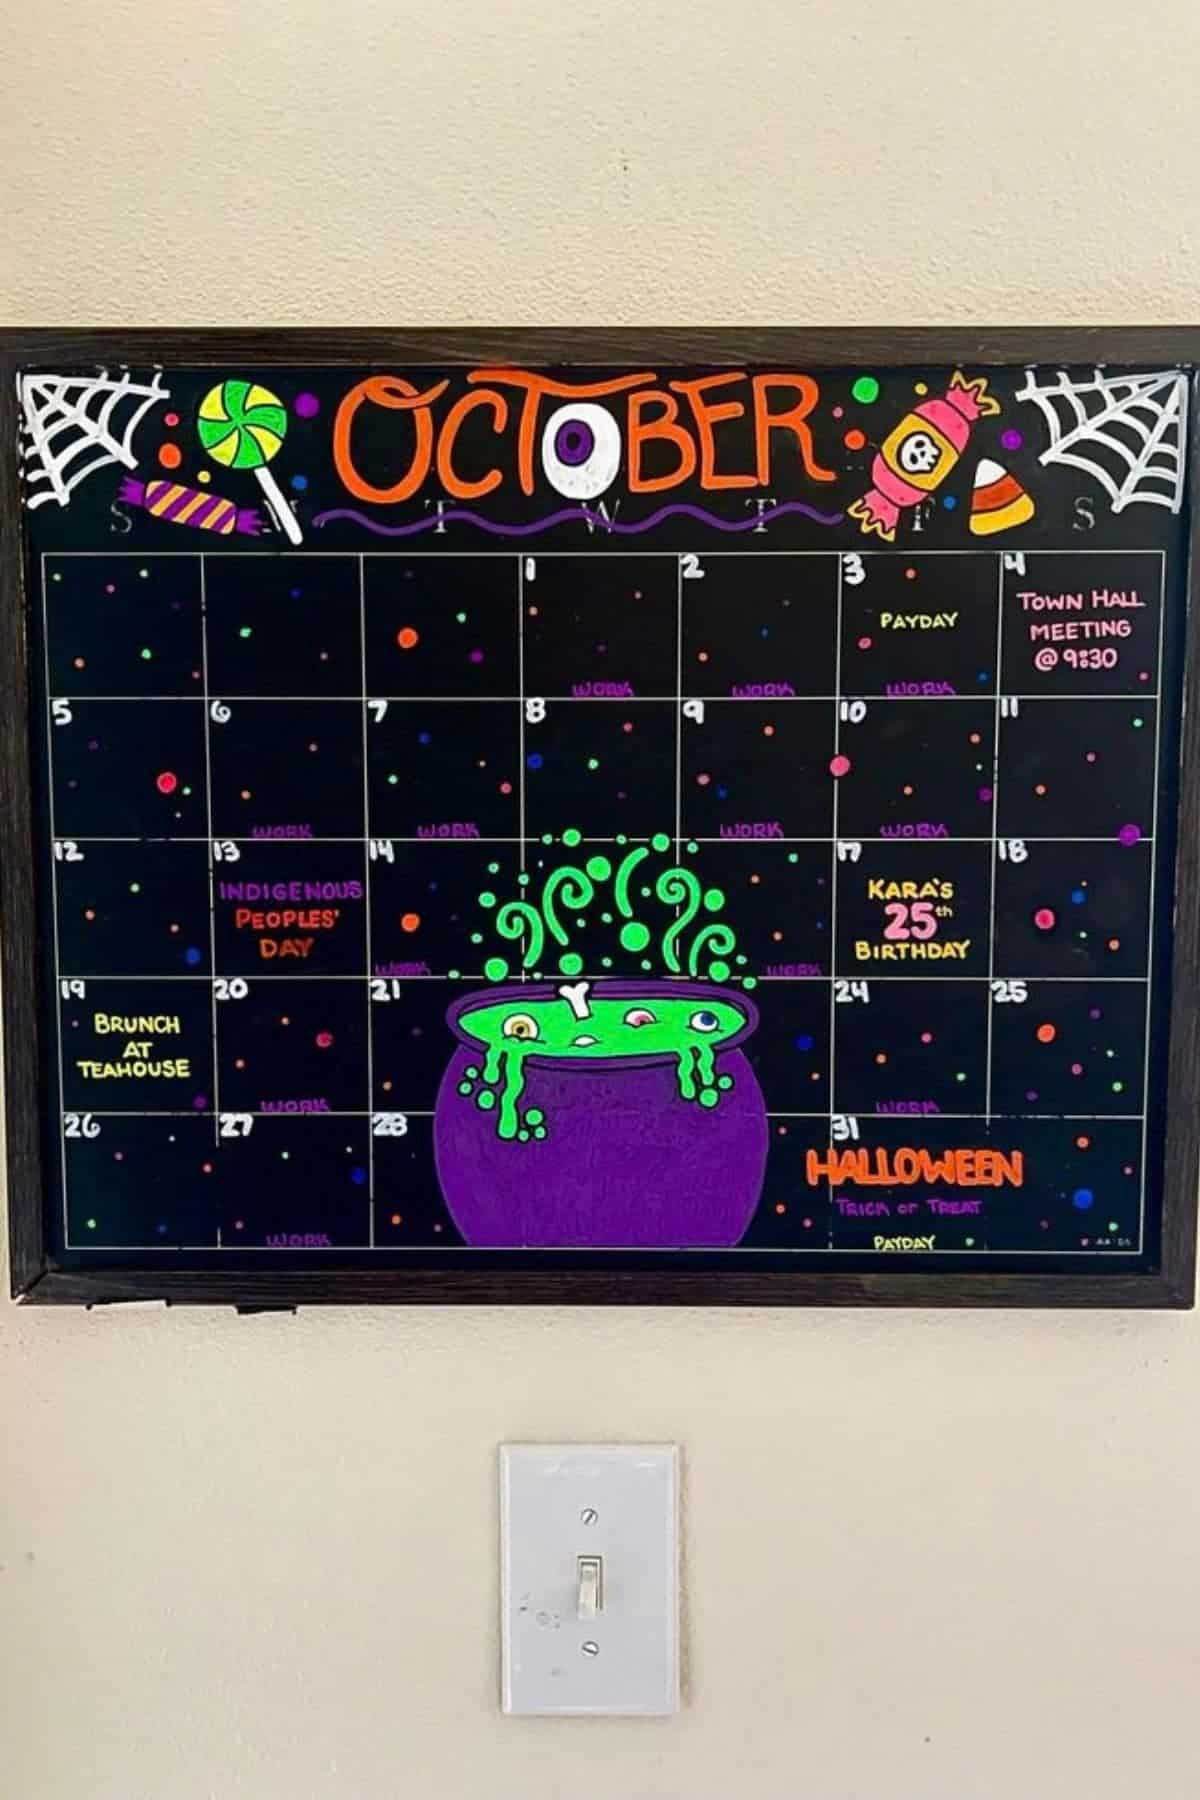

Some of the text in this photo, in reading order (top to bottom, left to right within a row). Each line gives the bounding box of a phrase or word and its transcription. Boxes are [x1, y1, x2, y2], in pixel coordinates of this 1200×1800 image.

[333, 369, 835, 503] OCTOBER
[424, 499, 455, 533] T
[581, 499, 621, 533] W
[745, 498, 776, 533] T
[1073, 497, 1095, 531] S
[680, 554, 704, 578] 2
[842, 554, 866, 584] 3
[1003, 552, 1026, 576] 4
[1018, 590, 1145, 611] TOWN HALL
[881, 611, 958, 629] PAYDAY
[1030, 621, 1131, 641] MEETING
[1035, 647, 1118, 671] @ 9:30
[572, 681, 635, 698] WORK
[732, 681, 795, 699] WORK
[886, 681, 956, 697] WORK
[52, 701, 72, 724] 5
[210, 701, 231, 723] 6
[367, 700, 387, 722] 7
[526, 697, 546, 723] 8
[683, 700, 704, 723] 9
[840, 700, 866, 722] 10
[1001, 697, 1018, 717] 11
[252, 825, 312, 840] WORK
[417, 823, 480, 838] WORK
[720, 823, 784, 838] WORK
[880, 823, 949, 838] WORK
[54, 841, 84, 862] 12
[213, 841, 240, 862] 13
[369, 840, 394, 863] 14
[999, 840, 1029, 863] 18
[220, 881, 362, 900] INDIGENOUS
[868, 877, 953, 899] KARA'S
[235, 909, 339, 930] PEOPLES'
[260, 938, 313, 959] DAY
[855, 940, 971, 960] BIRTHDAY
[62, 979, 85, 1000] 19
[214, 978, 248, 1000] 20
[371, 978, 400, 1000] 21
[833, 980, 869, 1003] 24
[990, 980, 1028, 1003] 25
[94, 1013, 180, 1033] BRUNCH
[122, 1042, 153, 1058] AT
[77, 1059, 190, 1078] TEAHOUSE
[260, 1100, 332, 1113] WORK
[876, 1101, 941, 1114] WORK
[64, 1113, 101, 1138] 26
[218, 1113, 254, 1137] 27
[371, 1113, 407, 1137] 28
[831, 1115, 860, 1140] 31
[806, 1147, 1024, 1187] HALLOWEEN
[926, 1198, 983, 1215] TREAT
[266, 1233, 331, 1248] WORK
[873, 1234, 936, 1251] PAYDAY
